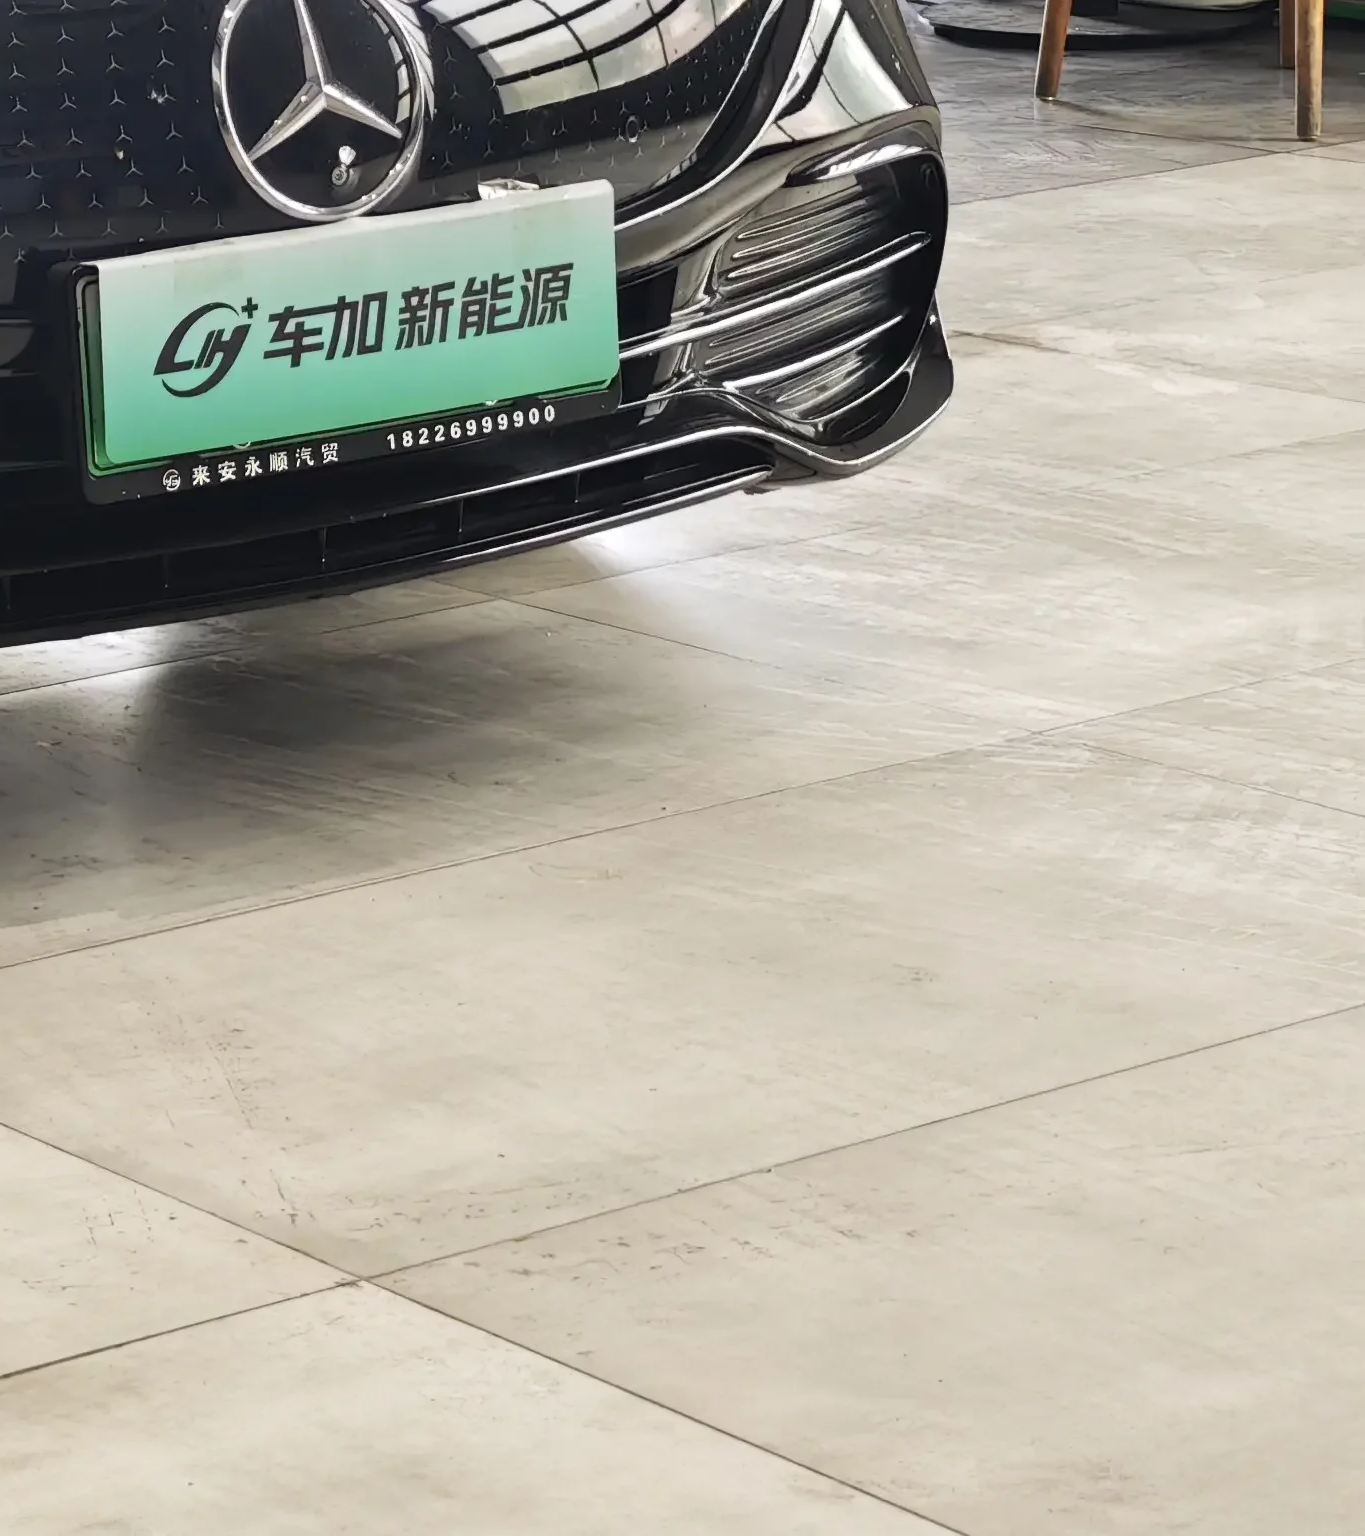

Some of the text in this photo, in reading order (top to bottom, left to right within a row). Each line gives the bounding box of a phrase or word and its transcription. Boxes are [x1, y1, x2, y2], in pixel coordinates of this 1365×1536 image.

[262, 262, 574, 369] 车加新能源
[191, 404, 557, 487] 来安永顺汽贸 18226999900
